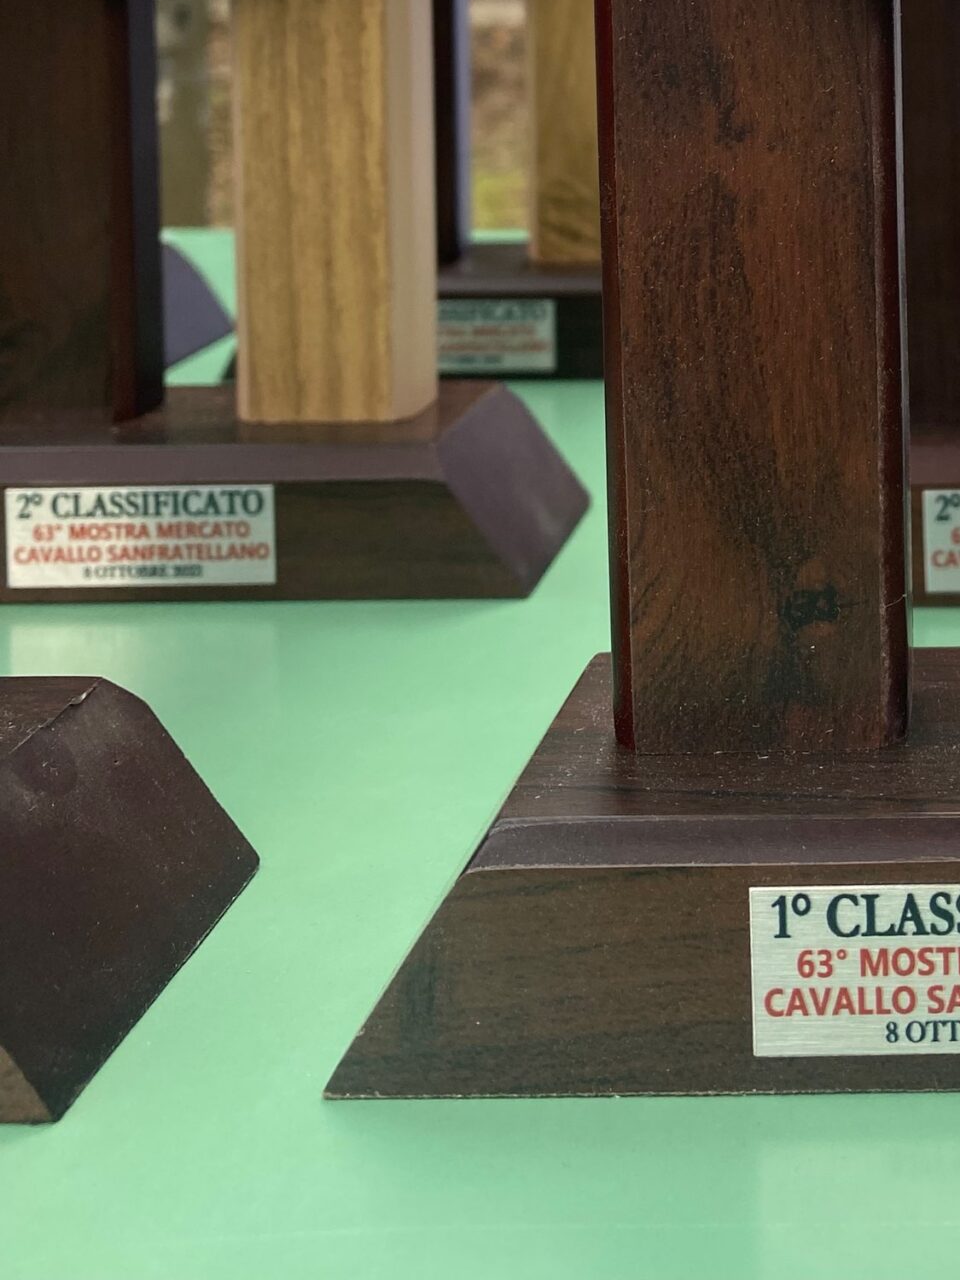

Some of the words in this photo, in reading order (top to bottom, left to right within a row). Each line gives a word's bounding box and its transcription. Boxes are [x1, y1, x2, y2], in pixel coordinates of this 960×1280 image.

[51, 490, 264, 517] CLASSIFICATO
[69, 523, 149, 541] MOSTRA
[156, 521, 250, 539] MERCATO
[14, 547, 102, 565] CAVALLO
[107, 543, 270, 562] SANFRATELLANO
[796, 948, 847, 978] 63°
[764, 985, 917, 1017] CAVALLO
[885, 1023, 898, 1043] 8
